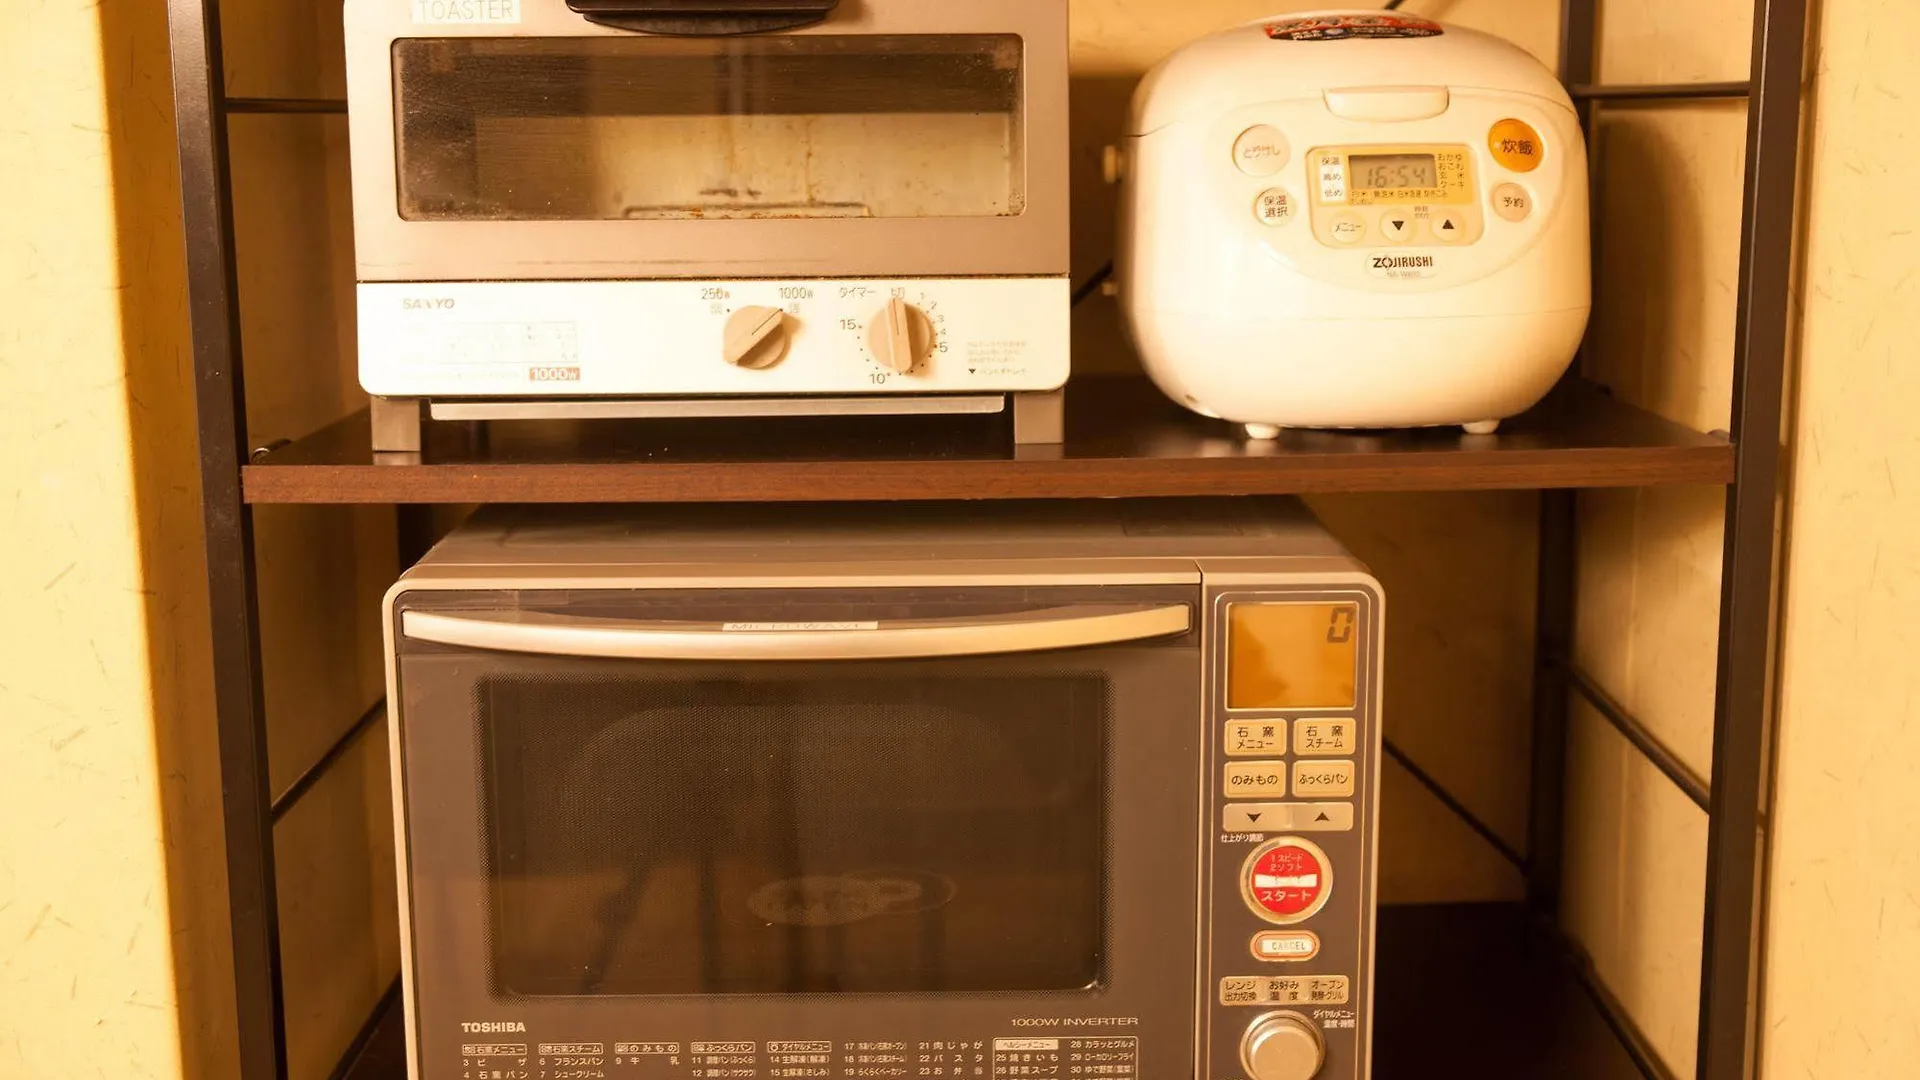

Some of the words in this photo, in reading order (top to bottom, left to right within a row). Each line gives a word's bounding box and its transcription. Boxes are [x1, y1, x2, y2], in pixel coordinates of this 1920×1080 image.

[418, 0, 513, 20] TOASTER
[1501, 138, 1533, 156] 炊飯
[1367, 166, 1426, 188] 16:54
[1264, 195, 1287, 206] 保温
[1503, 196, 1524, 208] 予約
[1264, 207, 1288, 217] 選択
[1335, 222, 1362, 232] メニュー
[1373, 256, 1433, 269] ZOJIRUSHI
[839, 287, 877, 298] タイマー
[839, 319, 857, 330] 15
[939, 342, 949, 353] 5
[870, 373, 886, 384] 10
[1327, 607, 1356, 643] 0
[1237, 739, 1274, 749] メニュー
[1306, 738, 1343, 749] スチーム
[1231, 774, 1278, 785] のみもの
[1299, 773, 1348, 784] ふっくらパン
[1261, 889, 1312, 902] スタート
[1225, 980, 1256, 990] レンジ
[1269, 980, 1299, 990] お好み
[1311, 980, 1344, 989] オーブン
[1011, 1017, 1059, 1026] 1000W
[1063, 1017, 1138, 1026] INVERTER
[461, 1022, 526, 1033] TOSHIBA
[630, 1044, 677, 1052] のみもの
[845, 1042, 854, 1050] 17
[919, 1042, 929, 1050] 21
[933, 1041, 983, 1050] 肉じゃが
[463, 1059, 470, 1067] 3
[477, 1058, 528, 1067] ピザ
[554, 1057, 604, 1066] フランスパン
[615, 1057, 622, 1065] 9
[692, 1056, 701, 1064] 11
[919, 1054, 930, 1062] 22
[934, 1054, 983, 1063] パスタ
[540, 1071, 546, 1079] 7
[555, 1070, 604, 1079] シュークリーム
[692, 1069, 702, 1077] 12
[919, 1067, 930, 1075] 23
[1070, 1065, 1082, 1074] 30
[463, 1071, 470, 1079] 4
